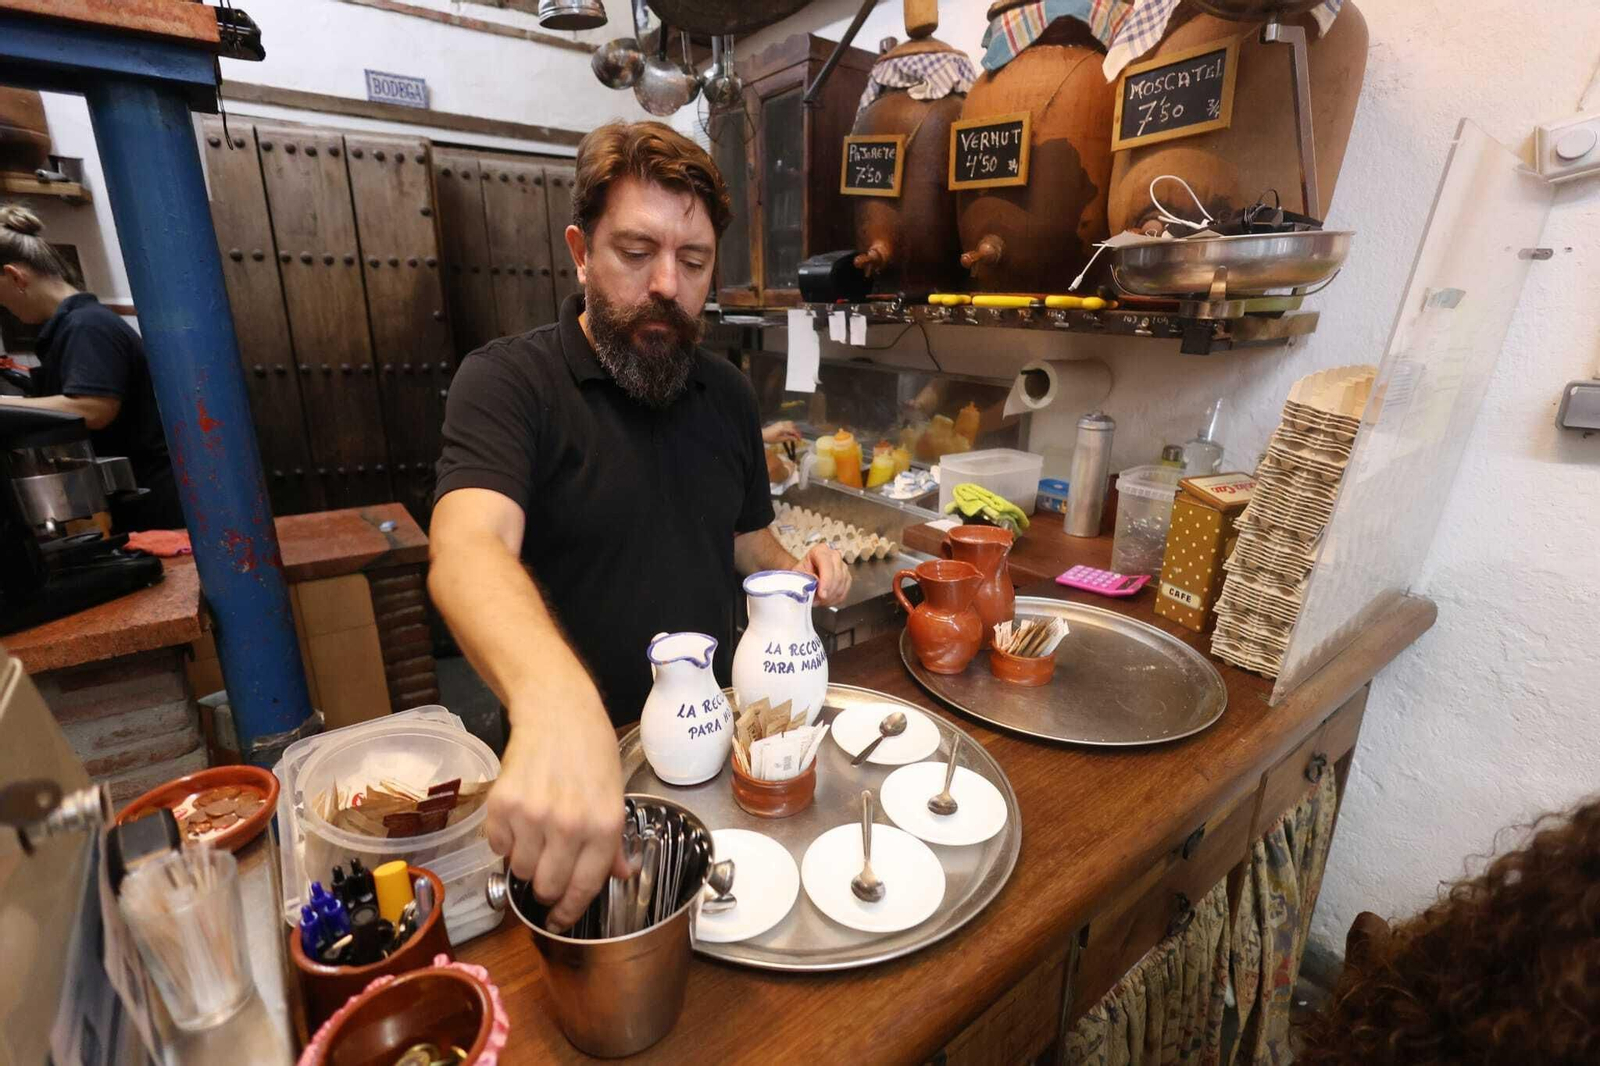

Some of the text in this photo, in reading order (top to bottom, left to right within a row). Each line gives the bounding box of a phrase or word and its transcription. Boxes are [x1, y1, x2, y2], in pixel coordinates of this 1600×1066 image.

[1129, 58, 1222, 100] MOSCATEL
[372, 77, 423, 101] BODEGA
[1168, 586, 1192, 604] CAFE
[764, 641, 782, 655] LA
[763, 660, 795, 674] PARA
[677, 703, 697, 719] LA
[688, 719, 722, 740] PARA
